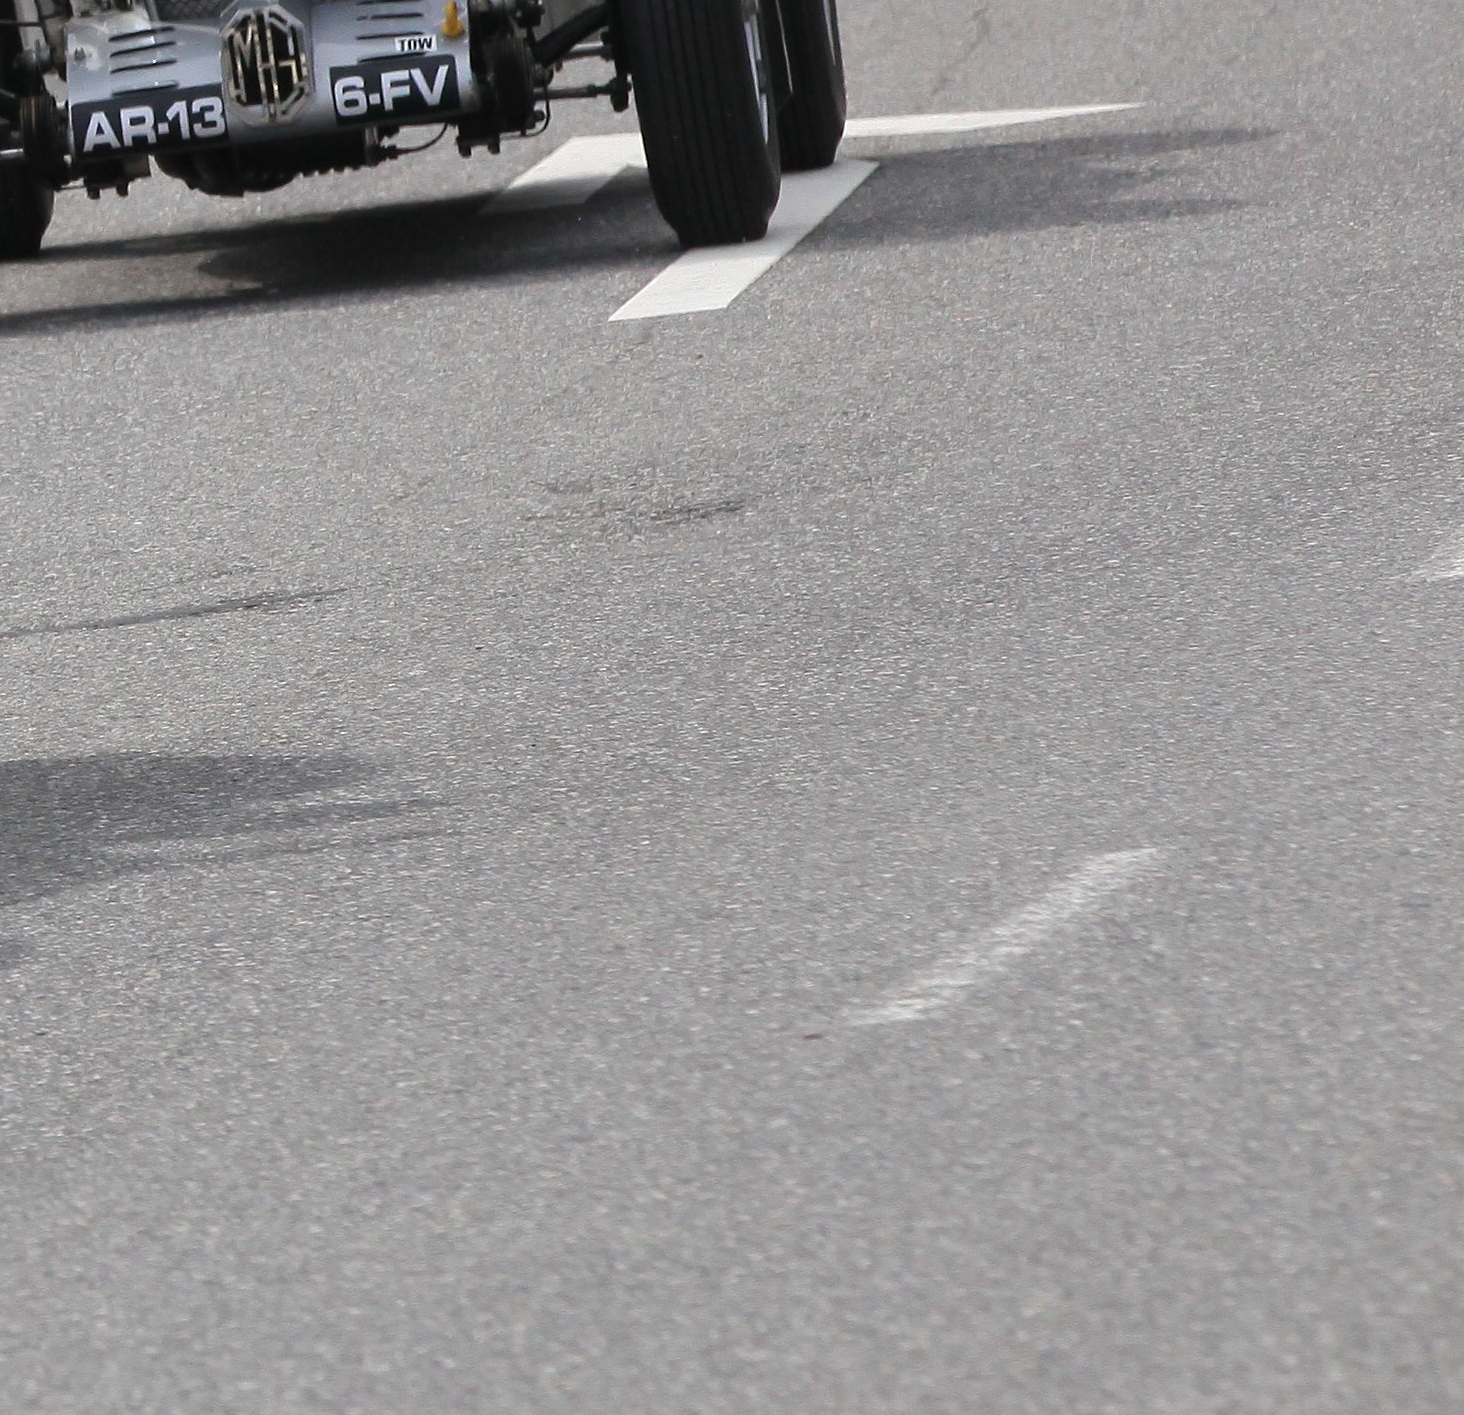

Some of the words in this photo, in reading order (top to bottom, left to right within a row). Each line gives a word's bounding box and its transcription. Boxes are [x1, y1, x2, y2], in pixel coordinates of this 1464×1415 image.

[398, 36, 434, 52] TOW
[83, 96, 226, 152] AR-13
[334, 64, 450, 117] 6-FV
